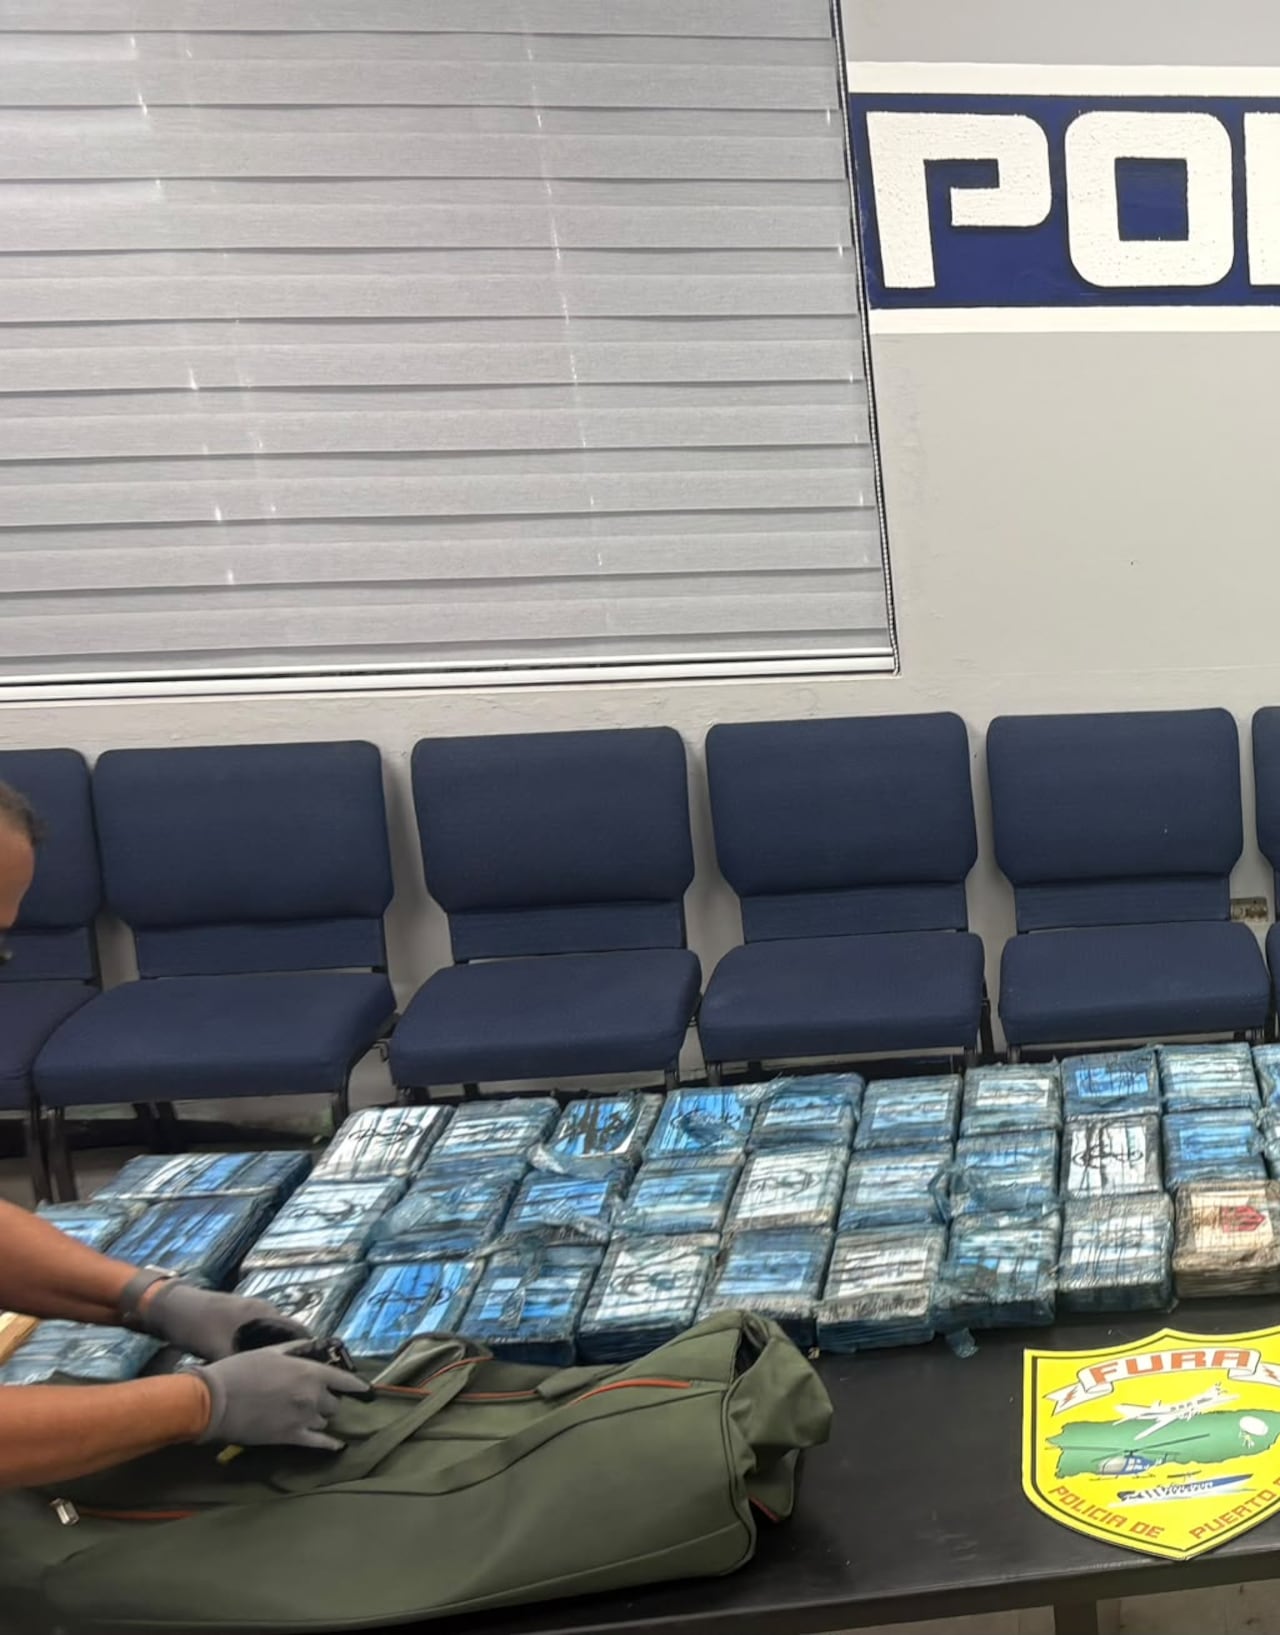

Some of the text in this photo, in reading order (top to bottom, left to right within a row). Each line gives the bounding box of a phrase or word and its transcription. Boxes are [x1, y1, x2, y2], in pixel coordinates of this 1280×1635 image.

[1089, 1350, 1251, 1386] FURA
[1048, 1484, 1129, 1528] POLICIA
[1129, 1521, 1165, 1539] DE
[1188, 1488, 1278, 1540] PUERTO
